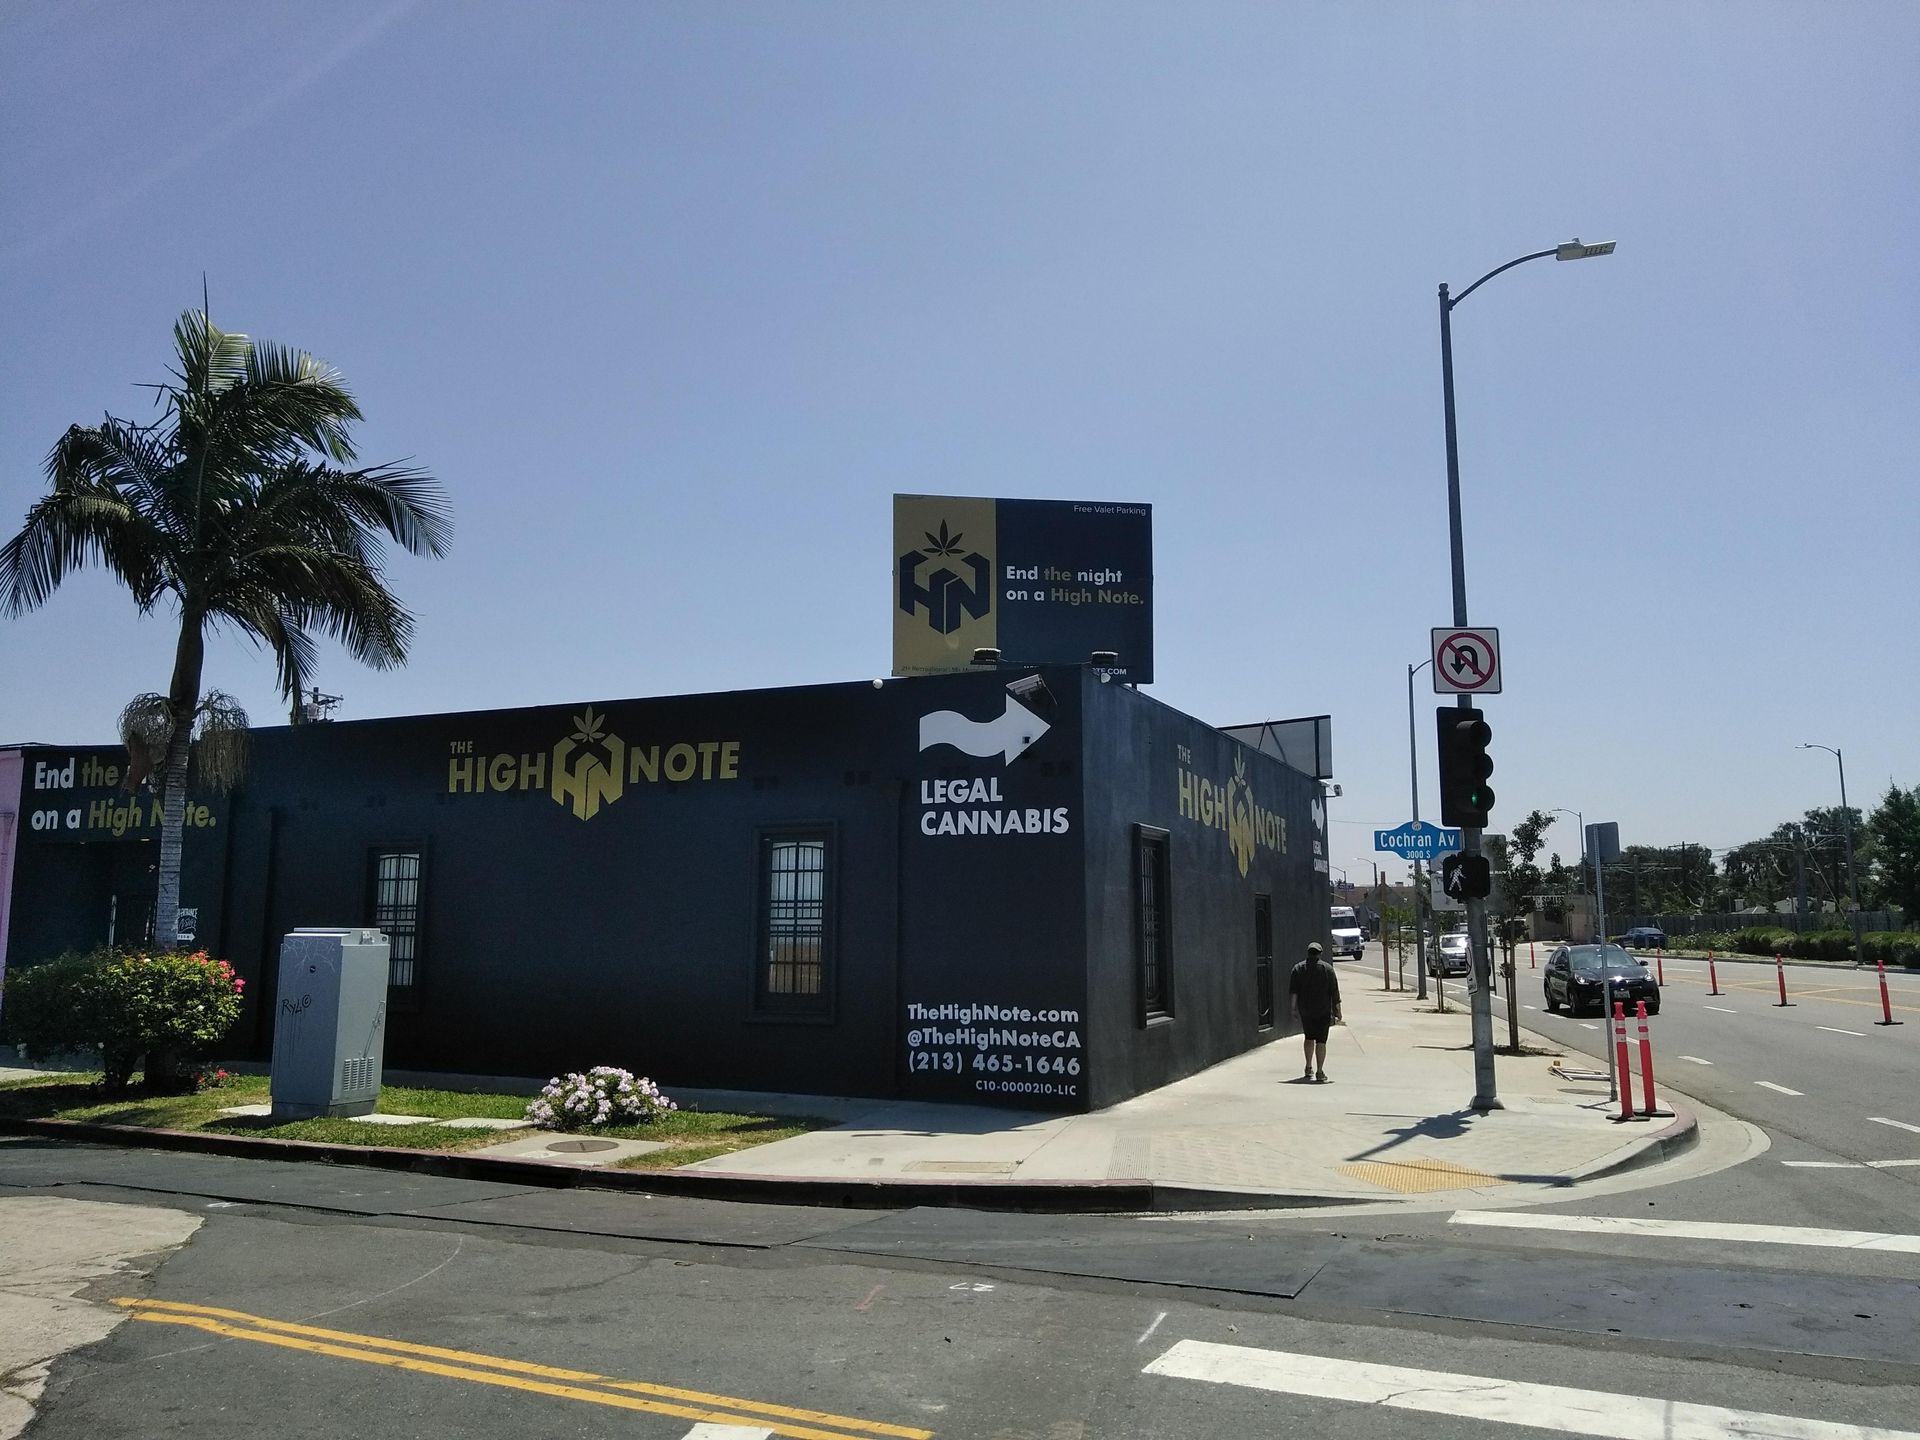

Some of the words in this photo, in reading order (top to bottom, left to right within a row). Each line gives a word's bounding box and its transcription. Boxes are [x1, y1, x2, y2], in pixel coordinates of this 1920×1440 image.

[1073, 504, 1093, 513] Free
[1094, 506, 1115, 514] Valet
[1116, 506, 1146, 516] Parking
[1006, 566, 1038, 580] End
[1044, 566, 1071, 581] the
[1077, 568, 1122, 586] night
[1006, 590, 1028, 601] on
[1033, 590, 1045, 601] a
[1051, 588, 1092, 606] High
[1098, 589, 1144, 605] Note.
[450, 741, 473, 754] THE
[1177, 744, 1192, 765] THE
[34, 757, 75, 790] End
[81, 755, 119, 787] the
[449, 752, 546, 793] HIGH
[629, 741, 741, 784] NOTE
[921, 776, 1003, 804] LEGAL
[31, 808, 59, 831] on
[65, 808, 82, 830] a
[87, 797, 143, 837] High
[150, 799, 217, 828] Nte.
[920, 807, 1070, 836] CANNABIS
[1178, 767, 1227, 832] HIGH
[1254, 804, 1287, 855] NOTE
[1380, 832, 1432, 848] Cochran
[1438, 831, 1455, 847] Av
[1406, 850, 1424, 859] 3000
[1426, 850, 1431, 859] S
[907, 1003, 1079, 1025] TheHighNote.com
[907, 1027, 1081, 1051] @TheHighNoteCA
[909, 1050, 963, 1075] (213)
[972, 1053, 1081, 1076] 465-1646
[975, 1080, 1077, 1096] C10-0000210-LIC
